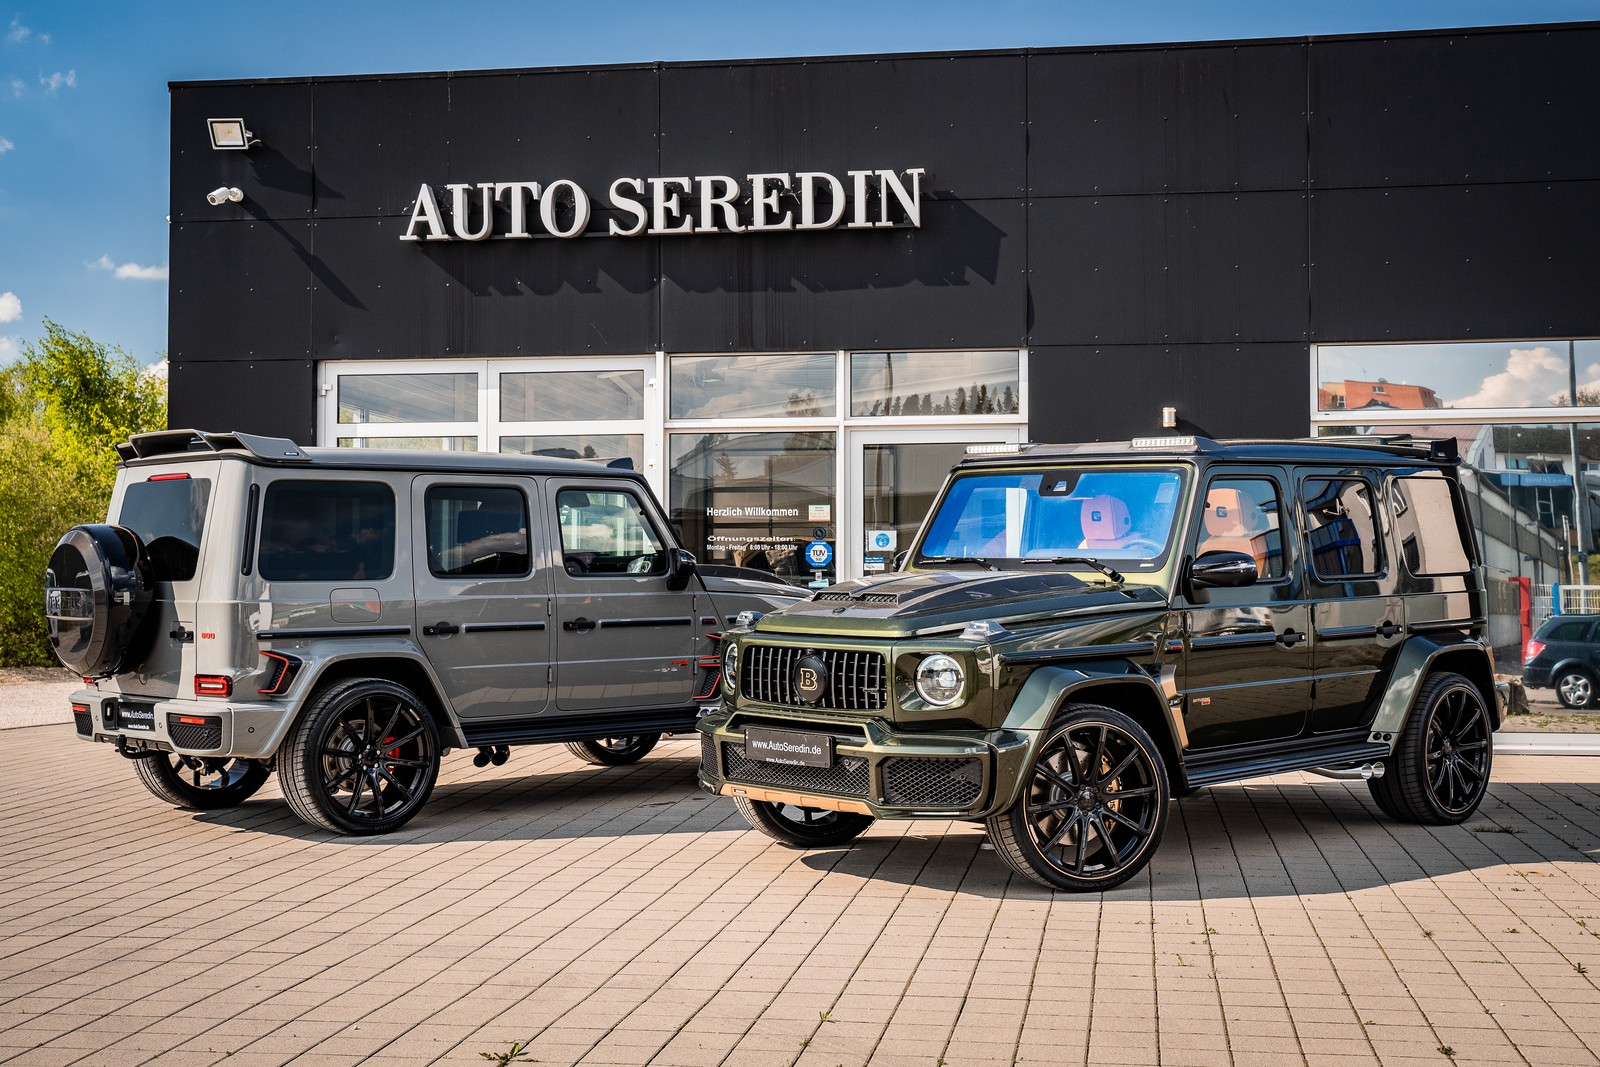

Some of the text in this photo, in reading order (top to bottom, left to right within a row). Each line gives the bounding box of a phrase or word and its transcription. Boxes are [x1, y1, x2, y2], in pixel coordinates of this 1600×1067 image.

[400, 168, 925, 242] AUTO SEREDIN
[706, 507, 799, 516] Herzlich Willkommen
[707, 535, 796, 543] Öffnungszeiten:
[706, 544, 726, 552] Montag
[201, 632, 216, 640] 800
[800, 667, 818, 691] B
[751, 740, 822, 755] www.AutoSeredin.de
[765, 757, 806, 766] www.AutoSeredin.de
